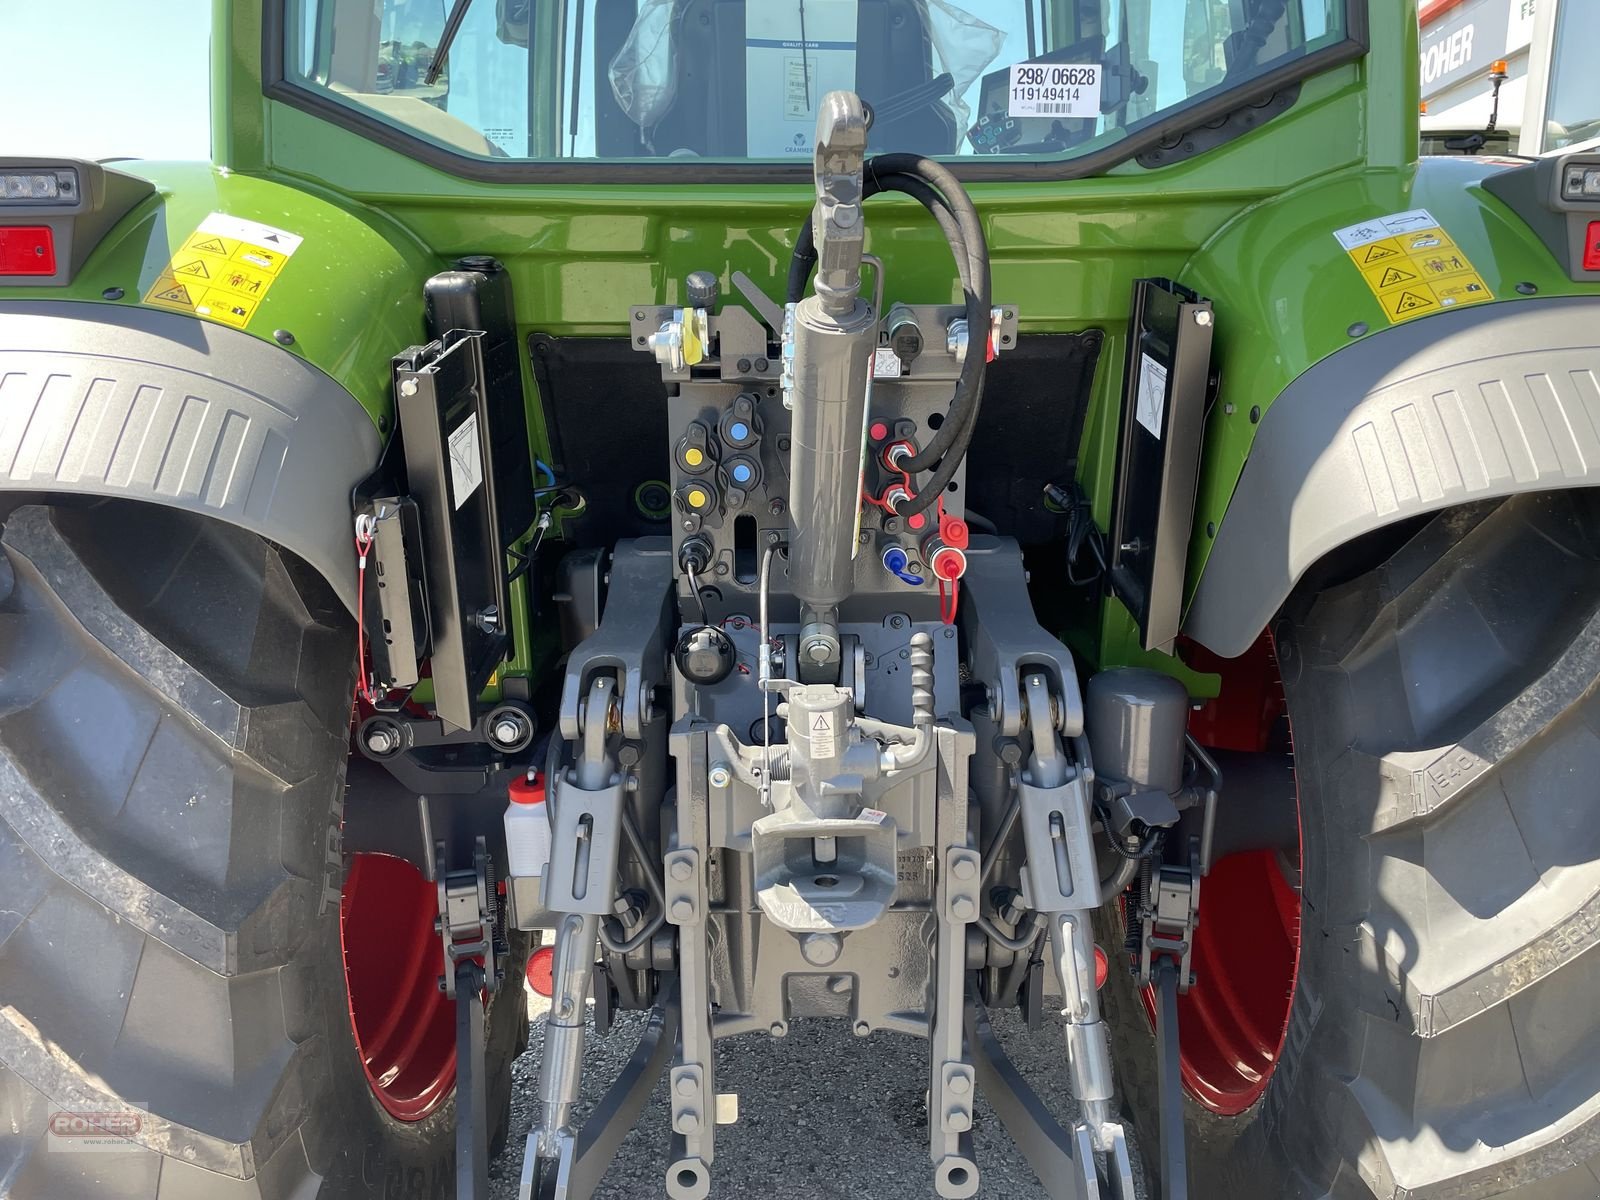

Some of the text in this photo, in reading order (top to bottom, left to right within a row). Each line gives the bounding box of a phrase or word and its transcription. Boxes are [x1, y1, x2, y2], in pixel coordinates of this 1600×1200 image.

[1017, 67, 1095, 86] 298/ 06628
[1012, 87, 1080, 100] 119149414
